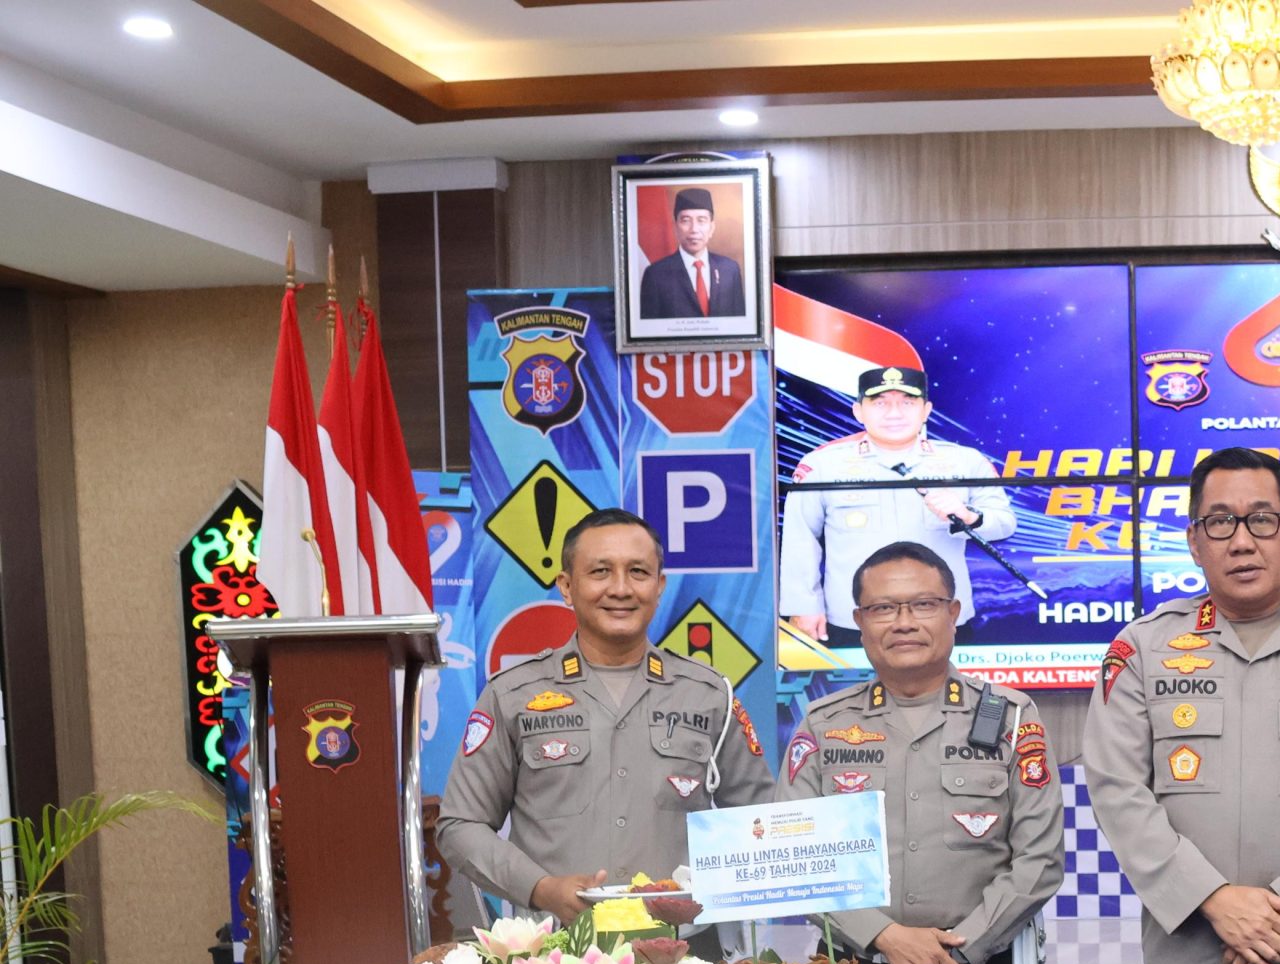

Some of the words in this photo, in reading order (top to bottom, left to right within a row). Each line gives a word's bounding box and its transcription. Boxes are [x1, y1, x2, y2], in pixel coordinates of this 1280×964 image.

[501, 314, 550, 331] KALIMANTAN
[551, 313, 584, 330] TENGAH
[643, 351, 746, 398] STOP
[1002, 447, 1178, 478] HARI
[665, 470, 728, 553] P
[957, 652, 991, 664] Drs.
[995, 652, 1046, 666] Djoko
[1050, 650, 1104, 662] Poerw
[1155, 678, 1218, 696] DJOKO
[522, 714, 584, 732] WARYONO
[652, 710, 710, 730] POLRI
[1018, 724, 1041, 735] OLDA
[823, 748, 885, 766] SUWARNO
[695, 857, 722, 869] HARI
[724, 853, 750, 867] LALU
[753, 847, 790, 863] LINTAS
[793, 838, 875, 859] BHAYANGKARA
[735, 866, 767, 882] KE-69
[770, 861, 808, 876] TAHUN
[810, 858, 837, 874] 2024
